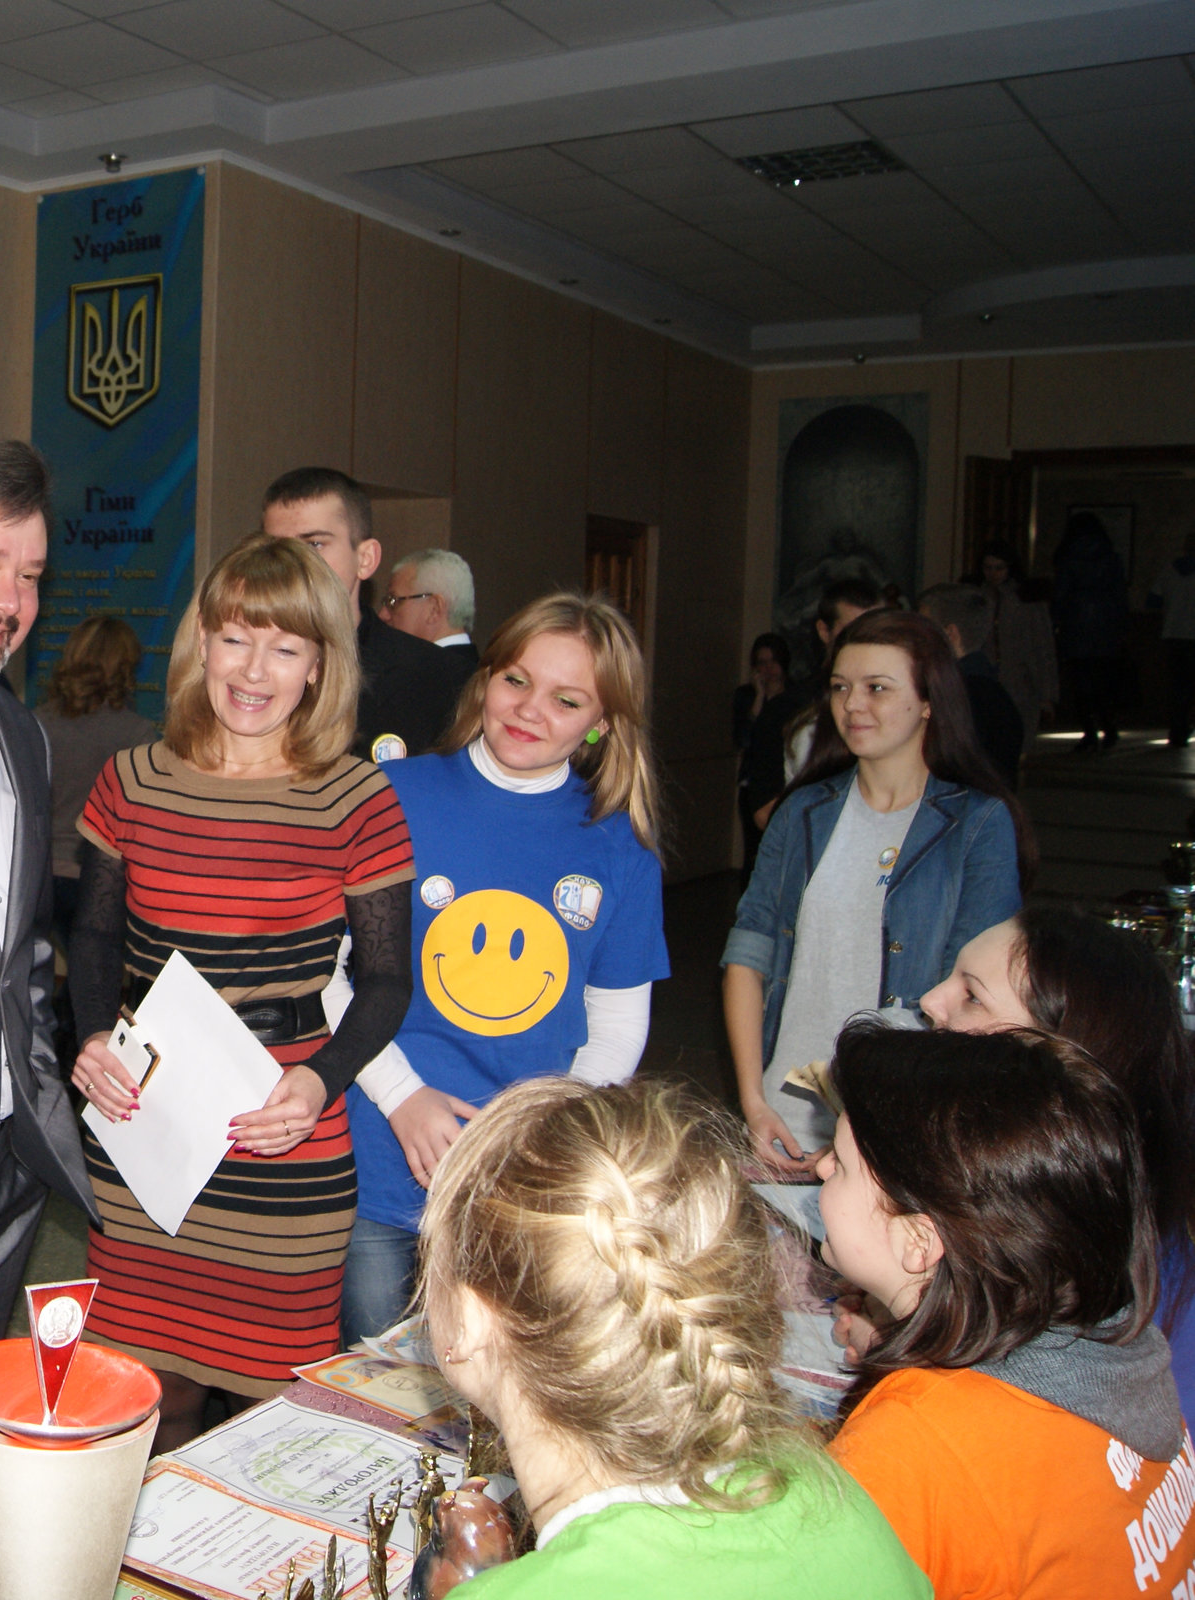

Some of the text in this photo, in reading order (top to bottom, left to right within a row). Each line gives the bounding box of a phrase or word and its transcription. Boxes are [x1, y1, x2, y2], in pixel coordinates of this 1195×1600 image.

[91, 195, 143, 226] Герб
[72, 230, 162, 263] України
[86, 486, 136, 513] Гімн
[64, 519, 155, 550] України
[310, 1456, 393, 1506] НАГОРОДЖУЄ
